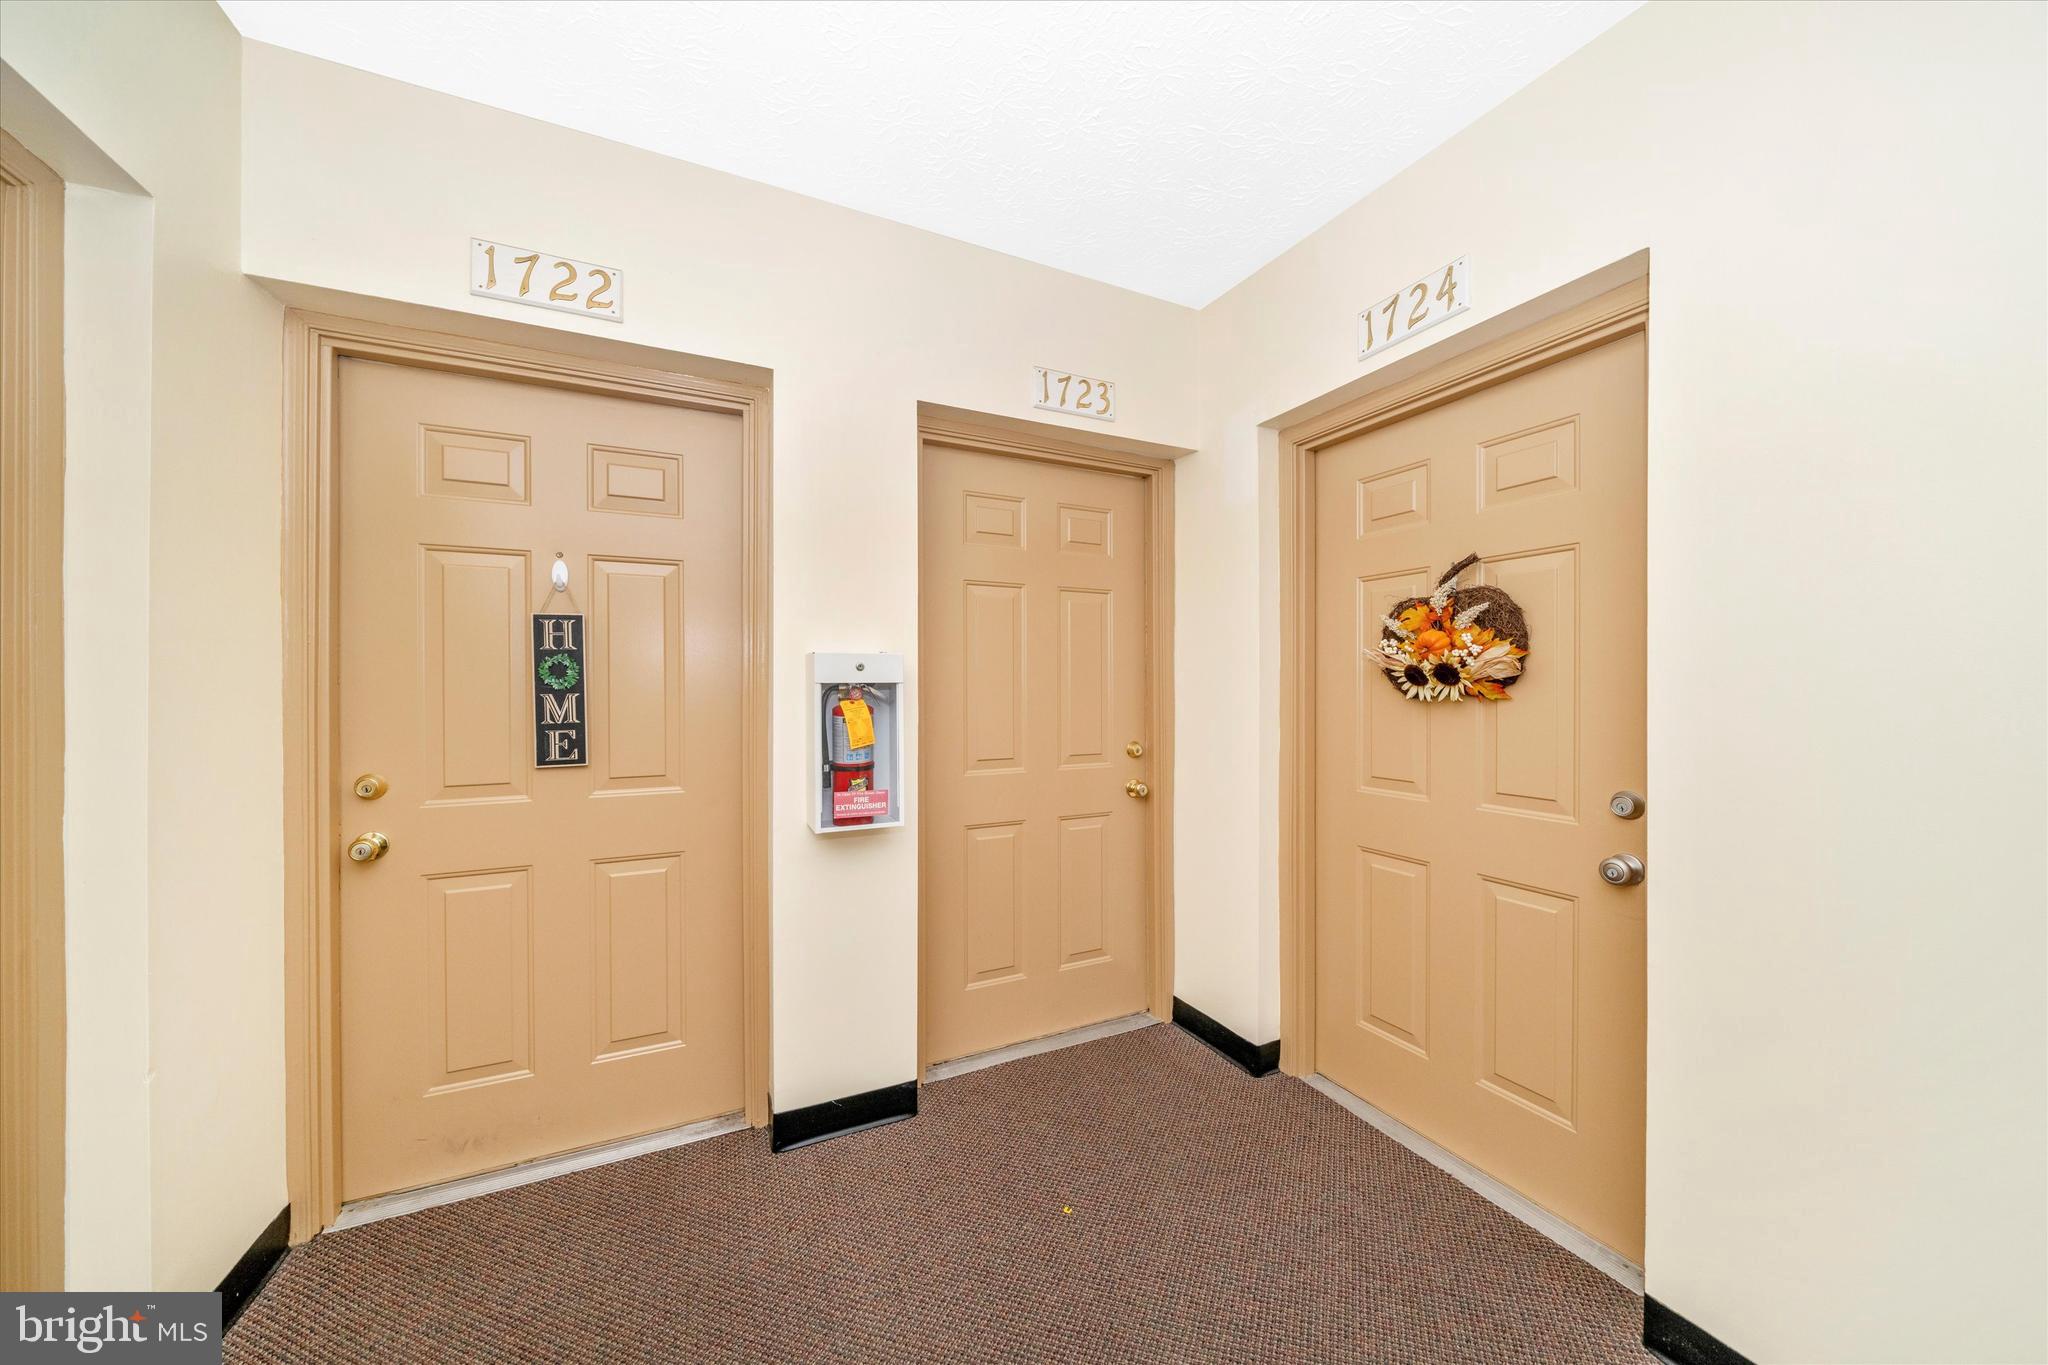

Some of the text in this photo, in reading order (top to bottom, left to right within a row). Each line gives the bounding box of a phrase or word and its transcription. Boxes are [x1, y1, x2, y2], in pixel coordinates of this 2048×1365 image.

[485, 245, 613, 309] 1722
[1365, 265, 1457, 351] 1724
[1042, 370, 1111, 415] 1723
[538, 619, 581, 762] HOME
[835, 802, 887, 811] EXTINGUISHER
